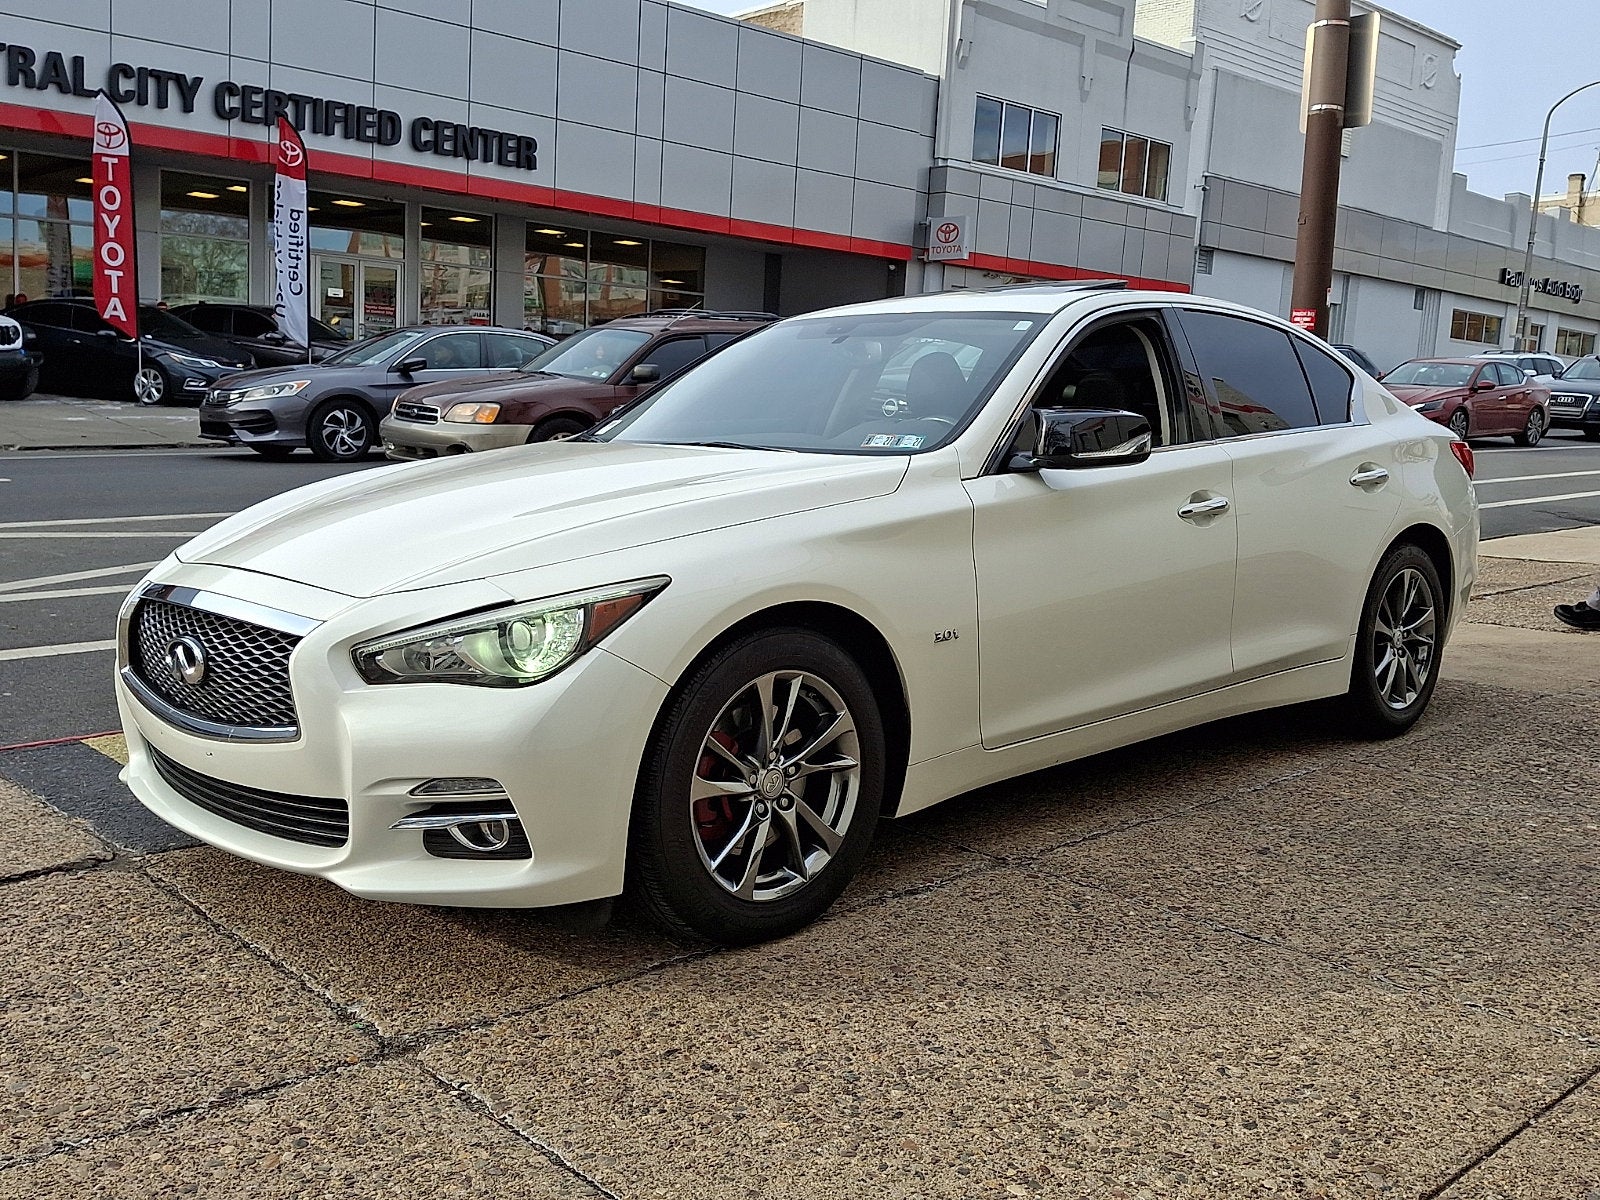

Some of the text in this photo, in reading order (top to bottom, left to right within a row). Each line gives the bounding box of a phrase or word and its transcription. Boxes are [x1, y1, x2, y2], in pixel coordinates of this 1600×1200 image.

[108, 62, 204, 113] CITY
[214, 81, 402, 146] CERTIFIED
[411, 116, 538, 171] CENTER
[99, 156, 128, 322] TOYOTA
[931, 244, 962, 255] TOYOTA
[1545, 279, 1564, 297] Auto
[1564, 283, 1583, 304] Body
